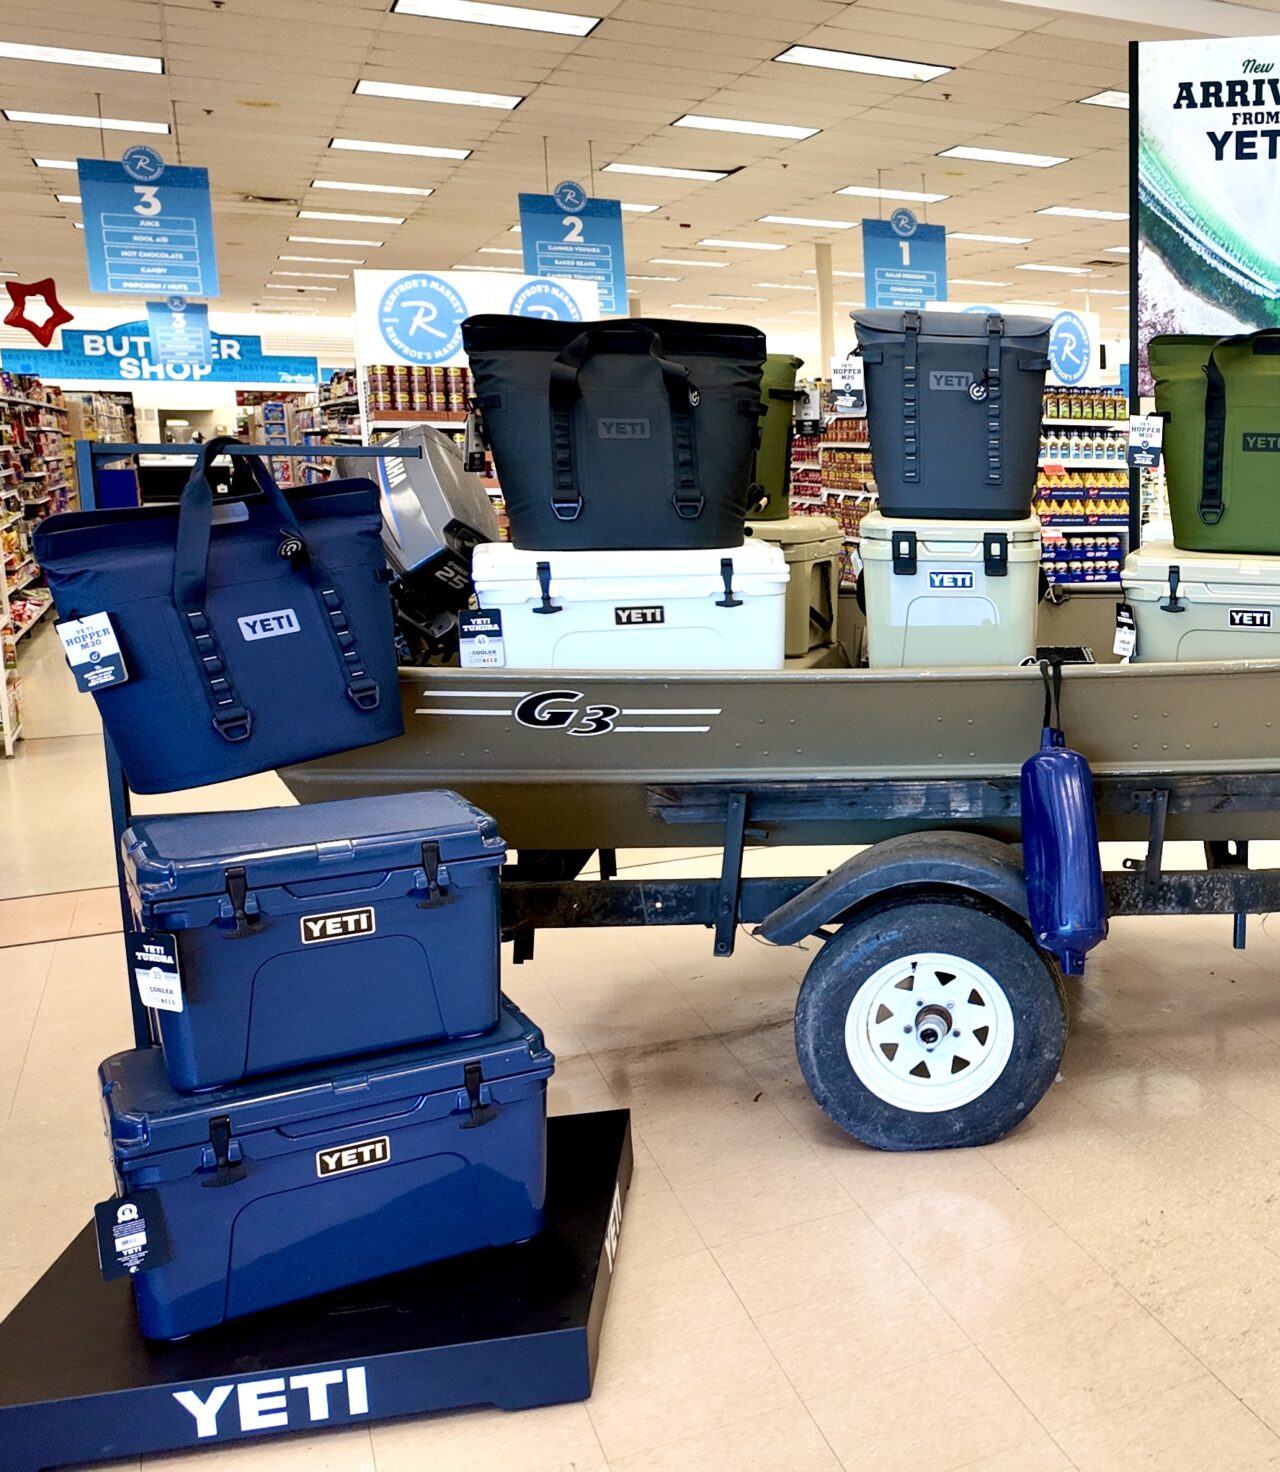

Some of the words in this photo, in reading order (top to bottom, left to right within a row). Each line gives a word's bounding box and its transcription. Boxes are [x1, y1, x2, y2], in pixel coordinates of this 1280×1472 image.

[1241, 58, 1275, 75] New
[1231, 110, 1280, 126] FROM
[133, 185, 162, 217] 3
[561, 215, 585, 243] 2
[121, 250, 138, 258] HOT
[138, 251, 184, 260] CHOCOLATE
[898, 240, 911, 267] 1
[140, 266, 168, 274] CANDY
[122, 281, 162, 290] POPCORN
[171, 312, 187, 330] 3
[400, 300, 448, 339] R
[83, 333, 242, 360] BUTER
[1058, 332, 1081, 365] R
[119, 357, 212, 381] SHOP
[932, 373, 970, 388] YETI
[601, 421, 647, 436] YETI
[382, 435, 408, 489] YAAHA
[434, 565, 469, 590] 25
[929, 573, 974, 588] YETI
[470, 617, 491, 625] YETI
[616, 608, 663, 623] YETI
[1231, 611, 1270, 626] YETI
[243, 614, 295, 636] YETI
[461, 623, 500, 632] TUNDRA
[64, 627, 111, 647] HOPPER
[80, 638, 102, 650] M30
[515, 689, 621, 736] G3
[305, 913, 372, 938] YETI
[135, 951, 175, 965] TUNDRA
[142, 943, 165, 955] YETI
[321, 1142, 385, 1170] YETI
[602, 1180, 623, 1274] YETI
[122, 1245, 142, 1256] YETI
[171, 1365, 370, 1439] YETI
